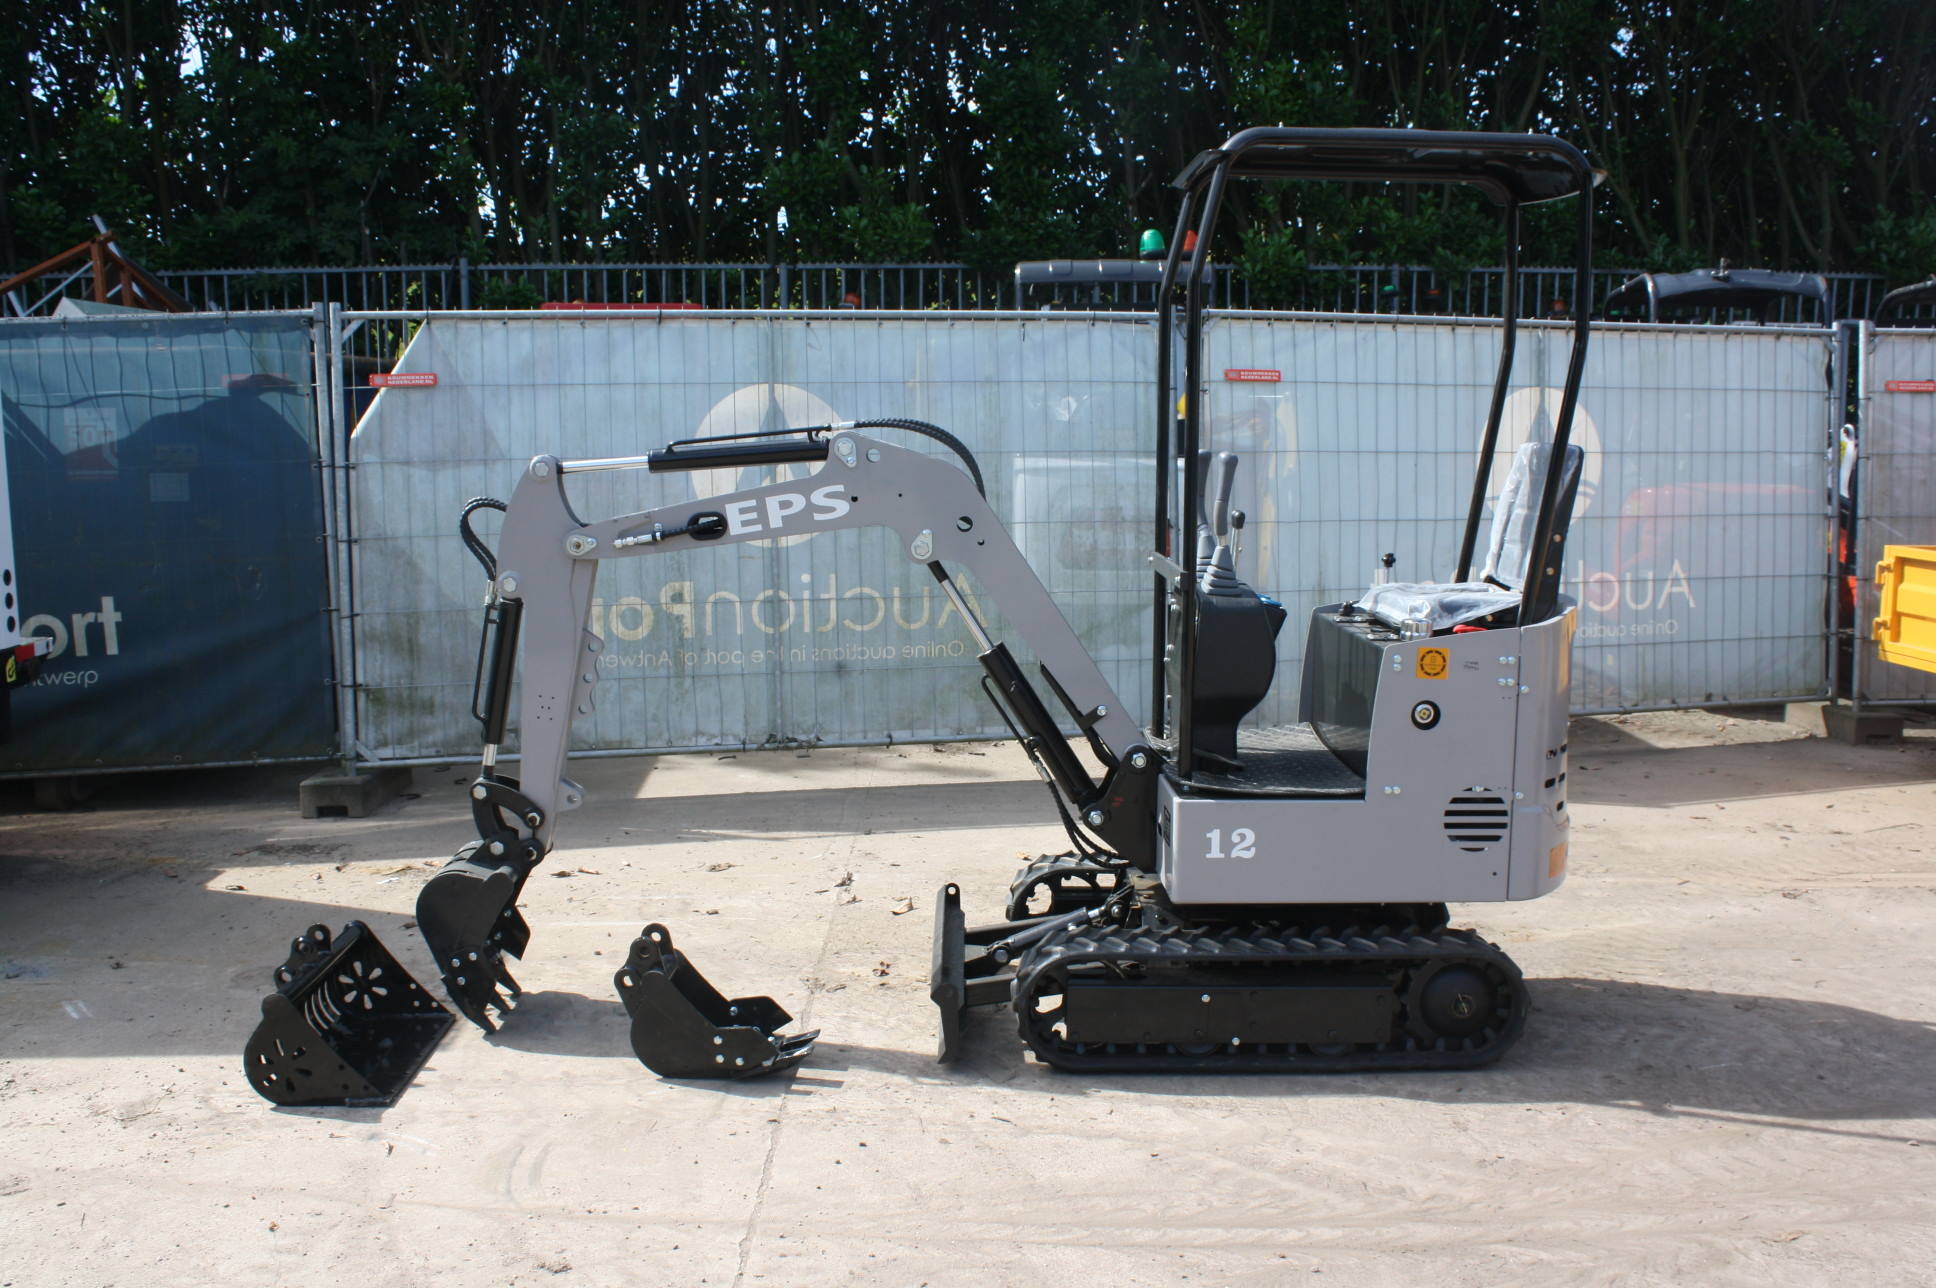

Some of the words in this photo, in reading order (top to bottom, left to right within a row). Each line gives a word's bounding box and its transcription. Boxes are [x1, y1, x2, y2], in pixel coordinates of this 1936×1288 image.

[725, 484, 850, 536] EPS
[20, 596, 122, 660] ort
[1205, 827, 1256, 859] 12
